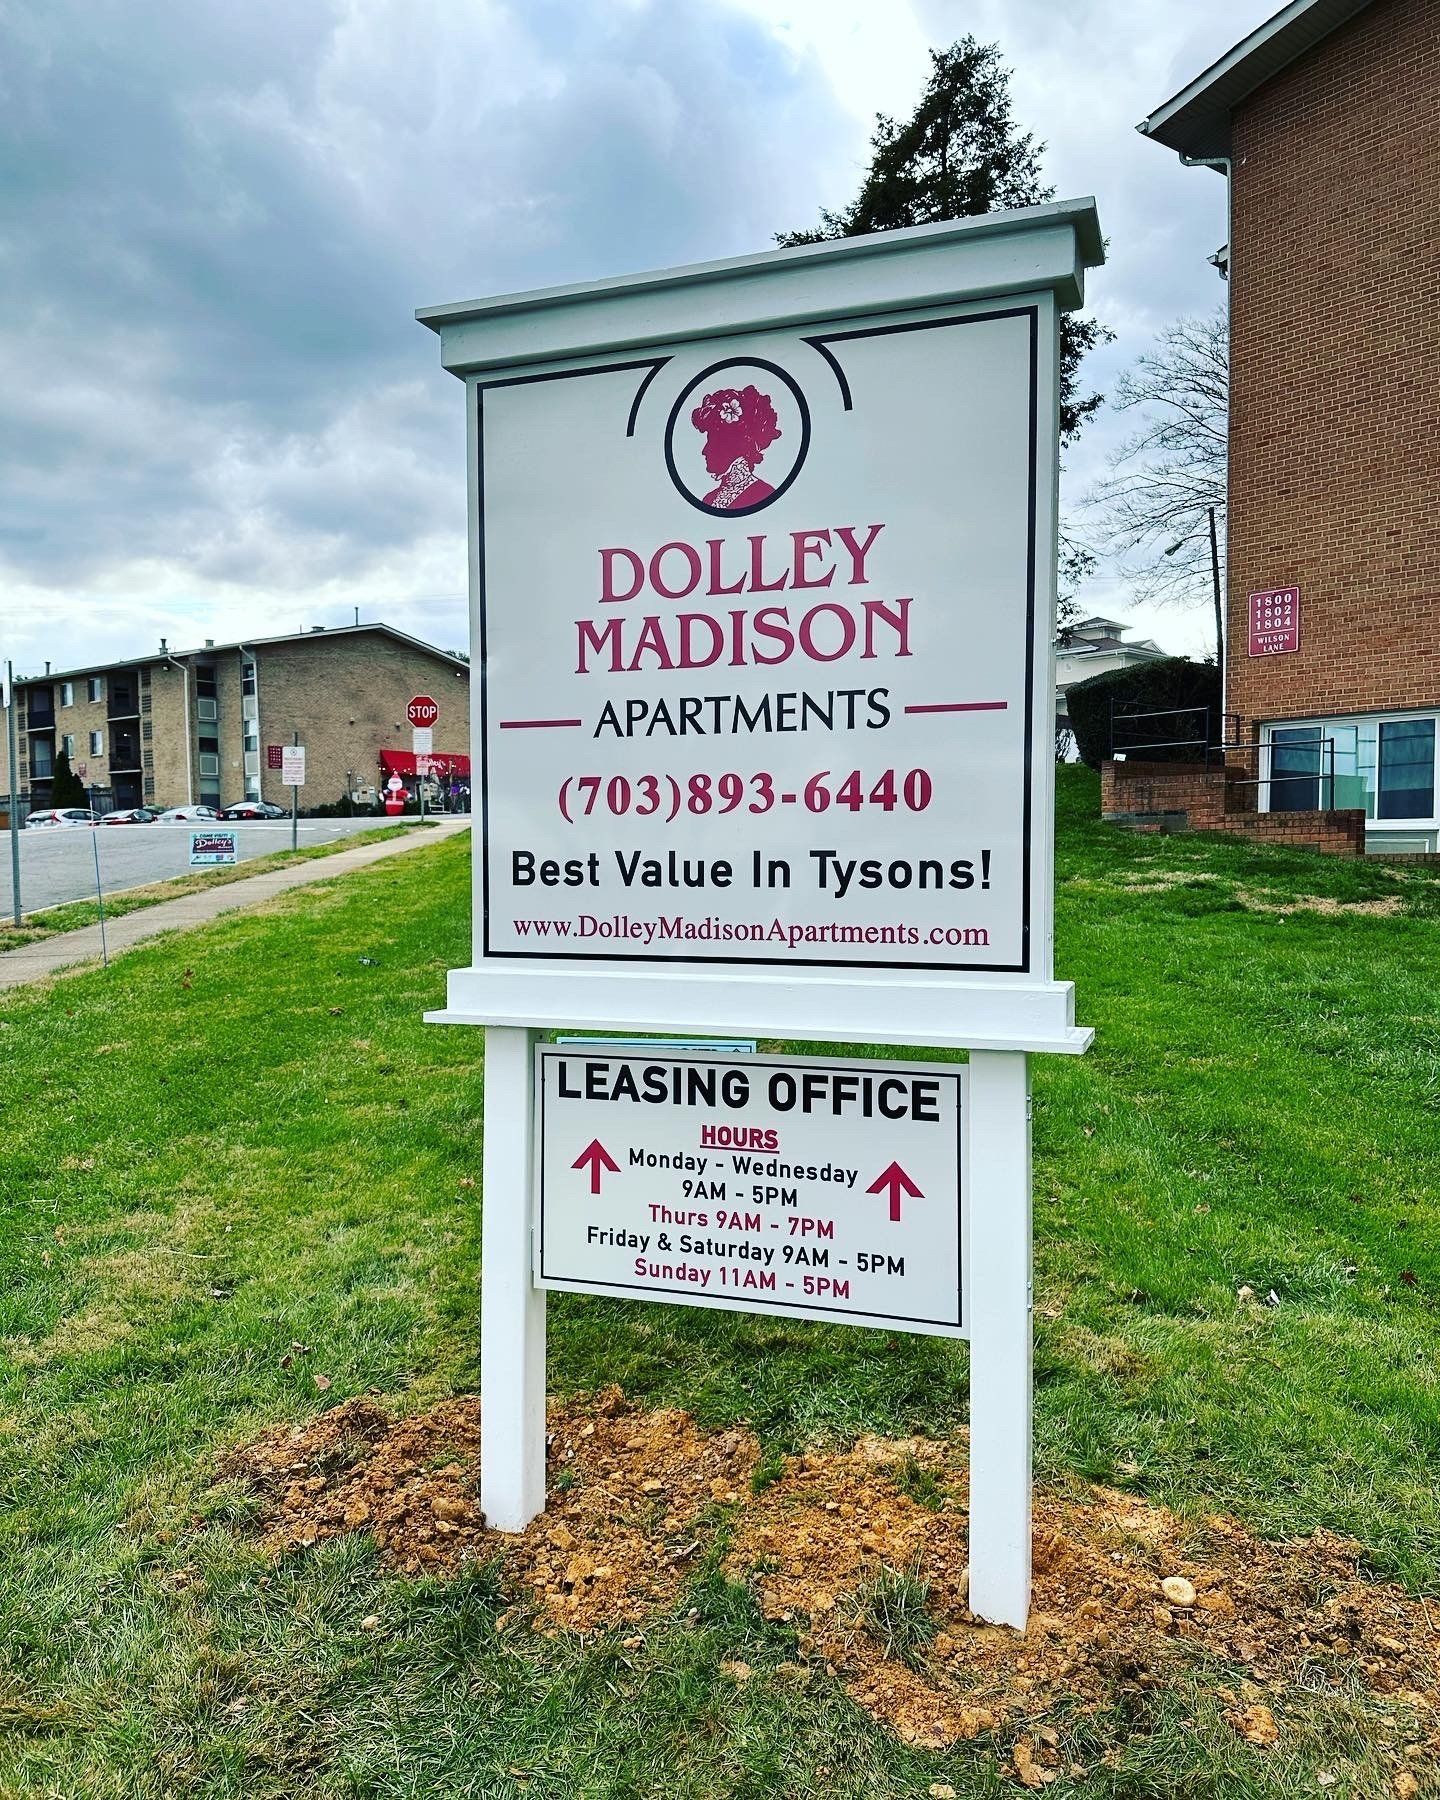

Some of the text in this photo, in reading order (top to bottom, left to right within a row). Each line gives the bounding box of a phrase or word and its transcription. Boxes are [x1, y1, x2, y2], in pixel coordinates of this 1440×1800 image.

[598, 524, 885, 603] DOLLEY
[1256, 594, 1292, 607] 1800
[1256, 605, 1291, 618] 1802
[575, 598, 913, 673] MADISON
[1256, 617, 1291, 630] 1804
[1257, 634, 1289, 644] WILSON
[1263, 643, 1284, 652] LANE
[409, 706, 436, 718] STOP
[593, 688, 890, 738] APARTMENTS
[559, 769, 931, 824] (703)893-6440
[195, 838, 231, 848] Dolley's
[513, 850, 990, 898] Best Value In Tysons!
[513, 916, 989, 948] www.DolleyMadisonApartments.com
[559, 1061, 940, 1122] LEASING OFFICE
[701, 1125, 778, 1147] HOURS
[630, 1147, 708, 1175] Monday
[732, 1156, 858, 1188] Wednesday
[683, 1180, 725, 1200] 9AM
[753, 1186, 797, 1207] 5PM
[649, 1204, 708, 1226] Thurs
[717, 1211, 760, 1232] 9AM
[789, 1217, 833, 1239] 7PM
[588, 1226, 650, 1253] Friday
[658, 1233, 672, 1251] &
[680, 1235, 774, 1265] Saturday
[783, 1246, 828, 1268] 9AM
[857, 1253, 904, 1276] 5PM
[634, 1258, 710, 1287] Sunday
[720, 1267, 775, 1290] 11AM
[804, 1276, 849, 1299] 5PM
